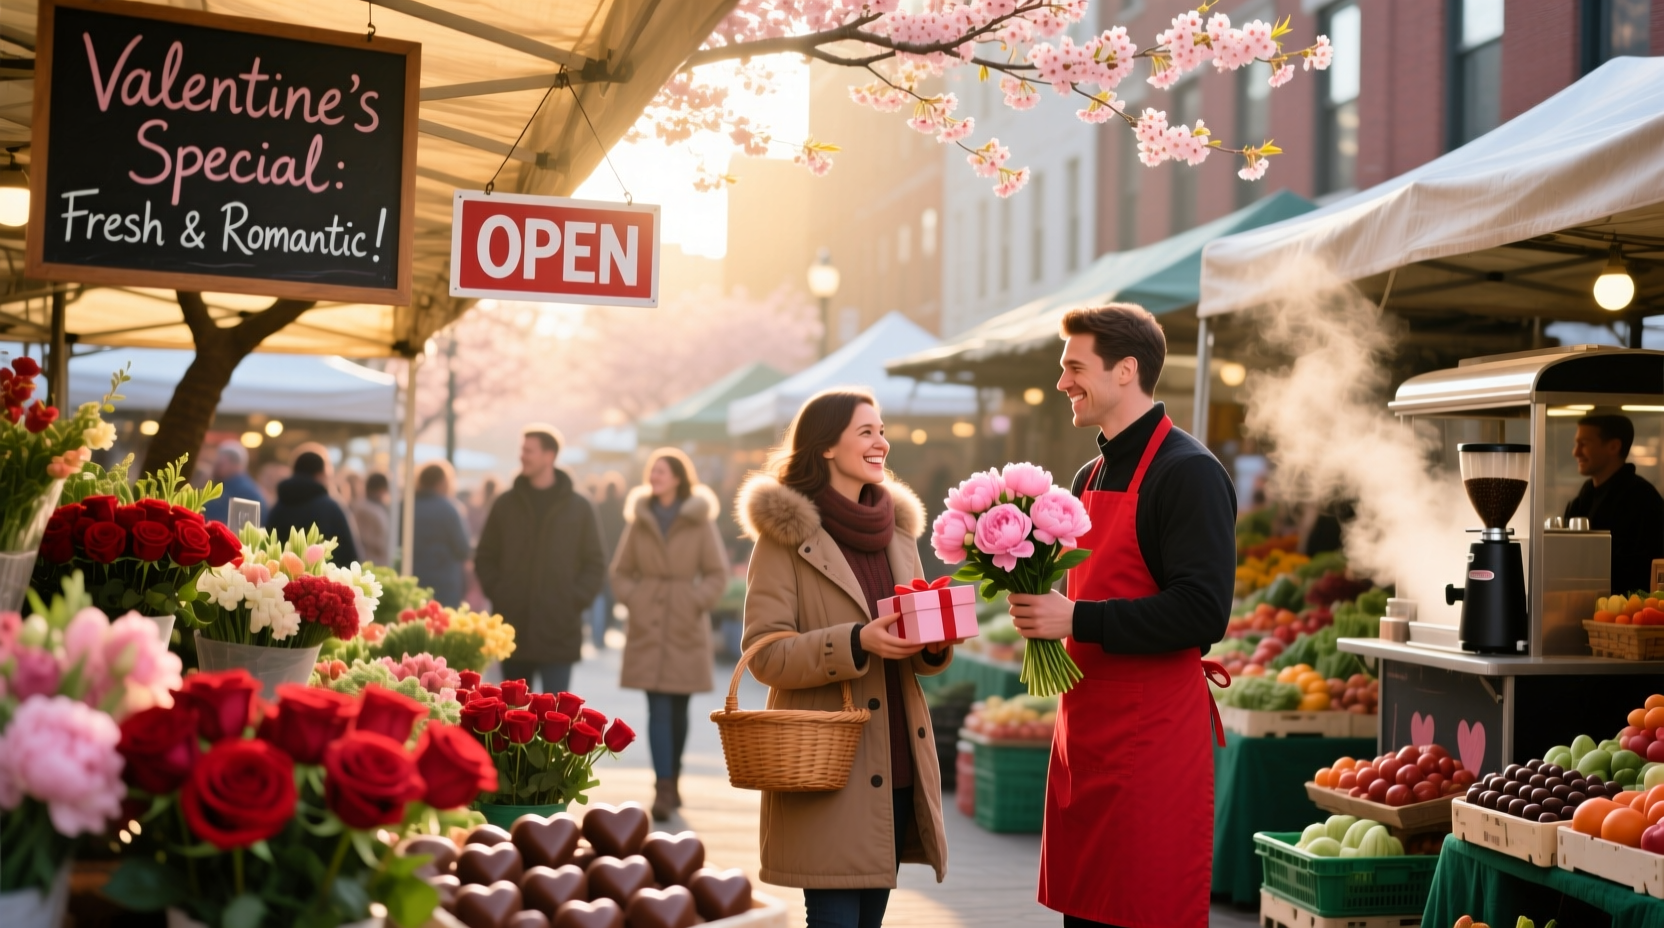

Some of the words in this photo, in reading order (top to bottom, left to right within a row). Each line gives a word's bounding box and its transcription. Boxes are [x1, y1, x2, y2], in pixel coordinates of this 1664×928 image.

[82, 32, 380, 133] Valentine's
[128, 118, 346, 206] Special:
[61, 188, 165, 247] Fresh
[179, 210, 206, 250] &
[220, 201, 388, 263] Romantic!
[476, 214, 639, 287] OPEN
